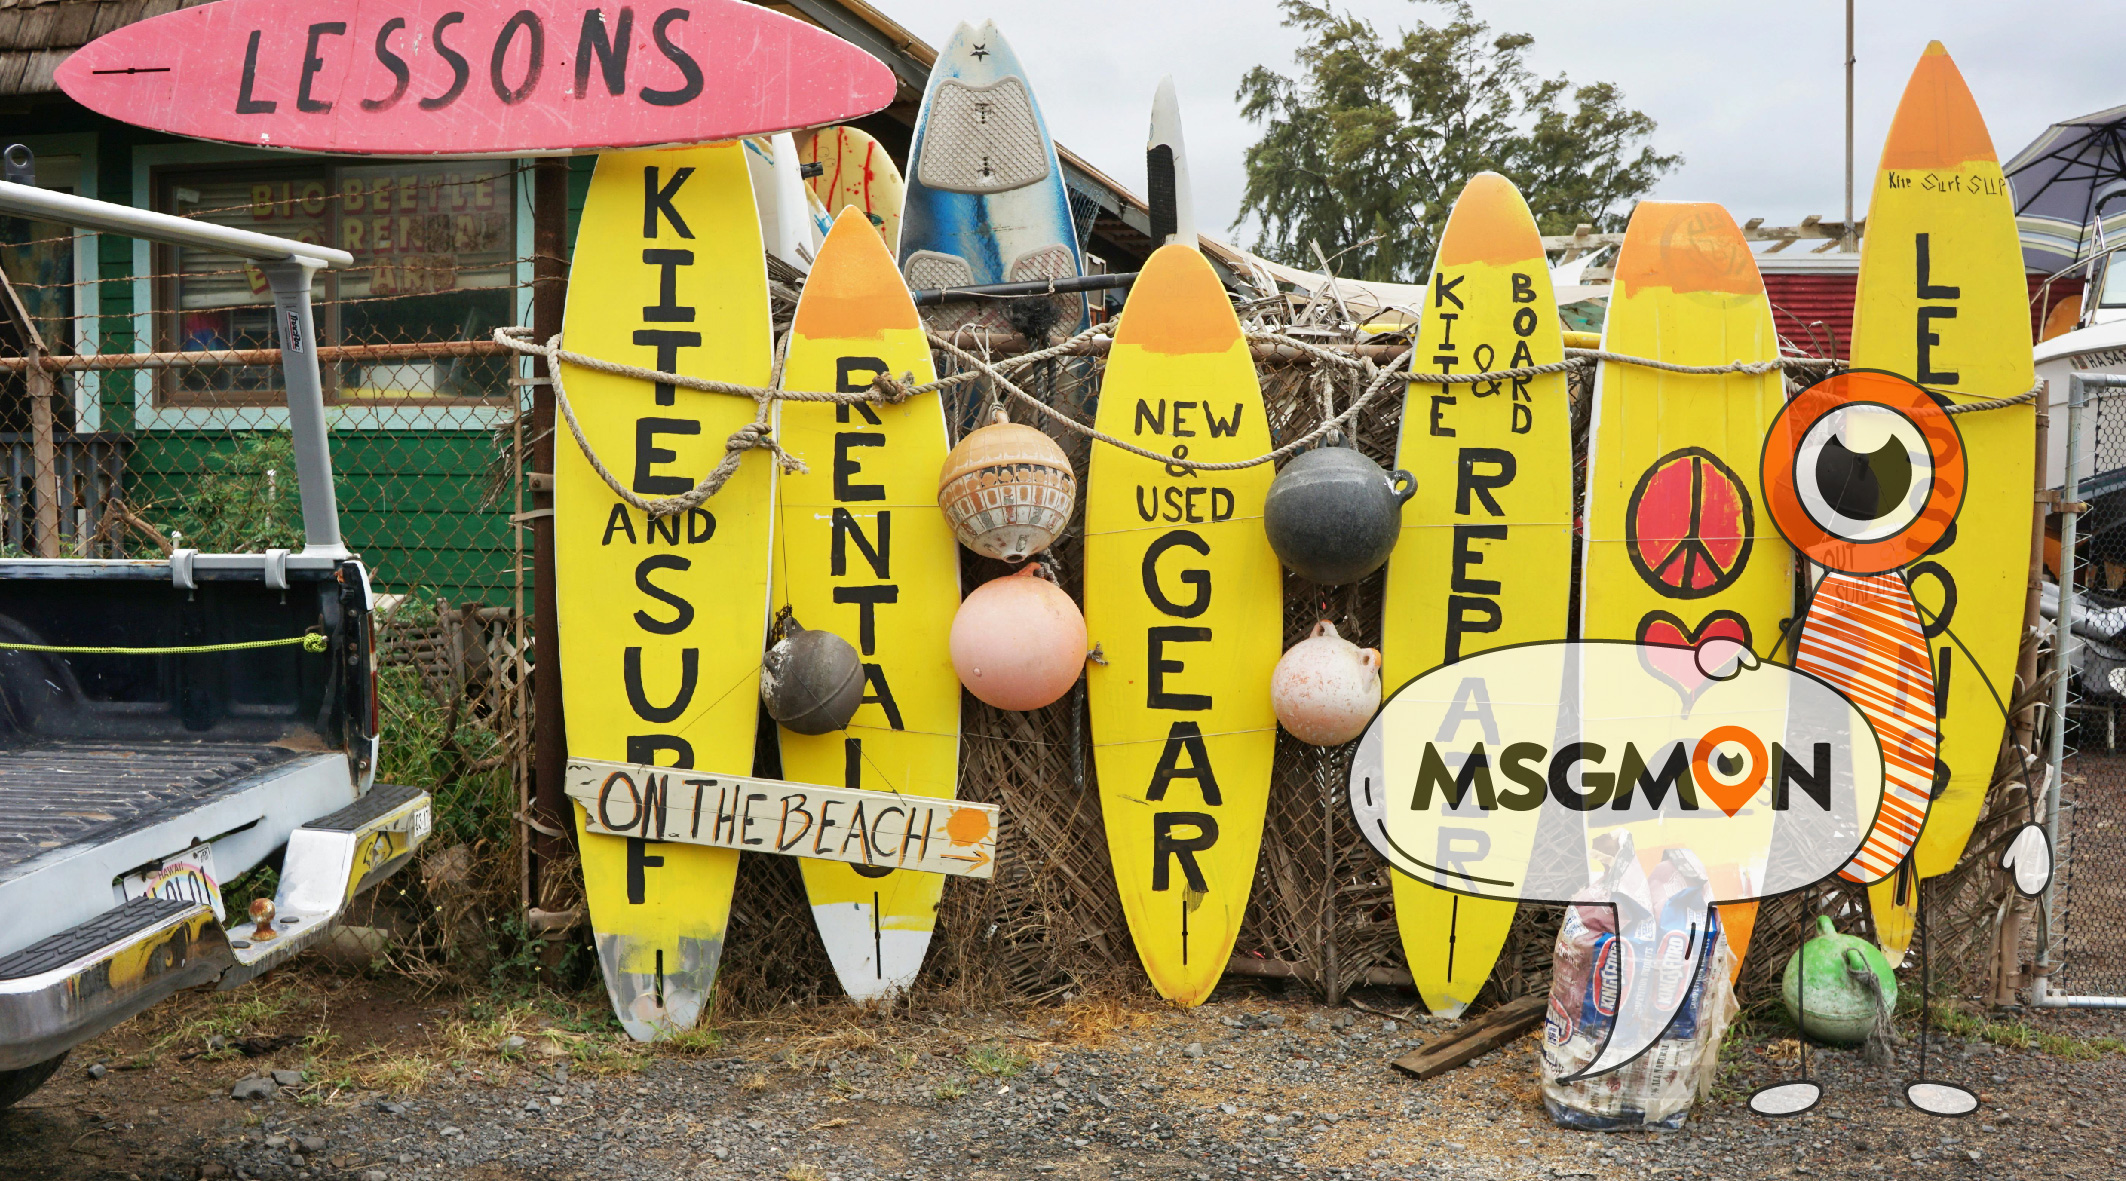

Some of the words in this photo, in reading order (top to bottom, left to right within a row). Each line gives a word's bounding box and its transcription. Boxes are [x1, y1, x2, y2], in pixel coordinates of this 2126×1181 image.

[235, 6, 704, 114] LESSONS
[342, 172, 496, 215] BEETLE
[1921, 172, 1961, 192] Surf
[1966, 175, 2006, 196] SUP
[632, 166, 702, 495] KITE
[1430, 273, 1464, 438] KITE
[1510, 273, 1537, 434] BOARD
[1471, 344, 1503, 398] &
[1134, 398, 1244, 438] NEW
[1165, 444, 1197, 478] &
[602, 502, 717, 546] AND
[1136, 484, 1235, 523] USED
[1893, 232, 1962, 801] LESSONS
[1433, 448, 1516, 895] REPAIR
[1142, 529, 1222, 892] GEAR
[598, 771, 668, 840] ON
[682, 779, 768, 846] THE
[775, 793, 934, 867] BEACH
[158, 861, 184, 880] HAWAII
[1600, 941, 1625, 1011] KINGSFORD
[1657, 937, 1684, 1005] KINGSFORD
